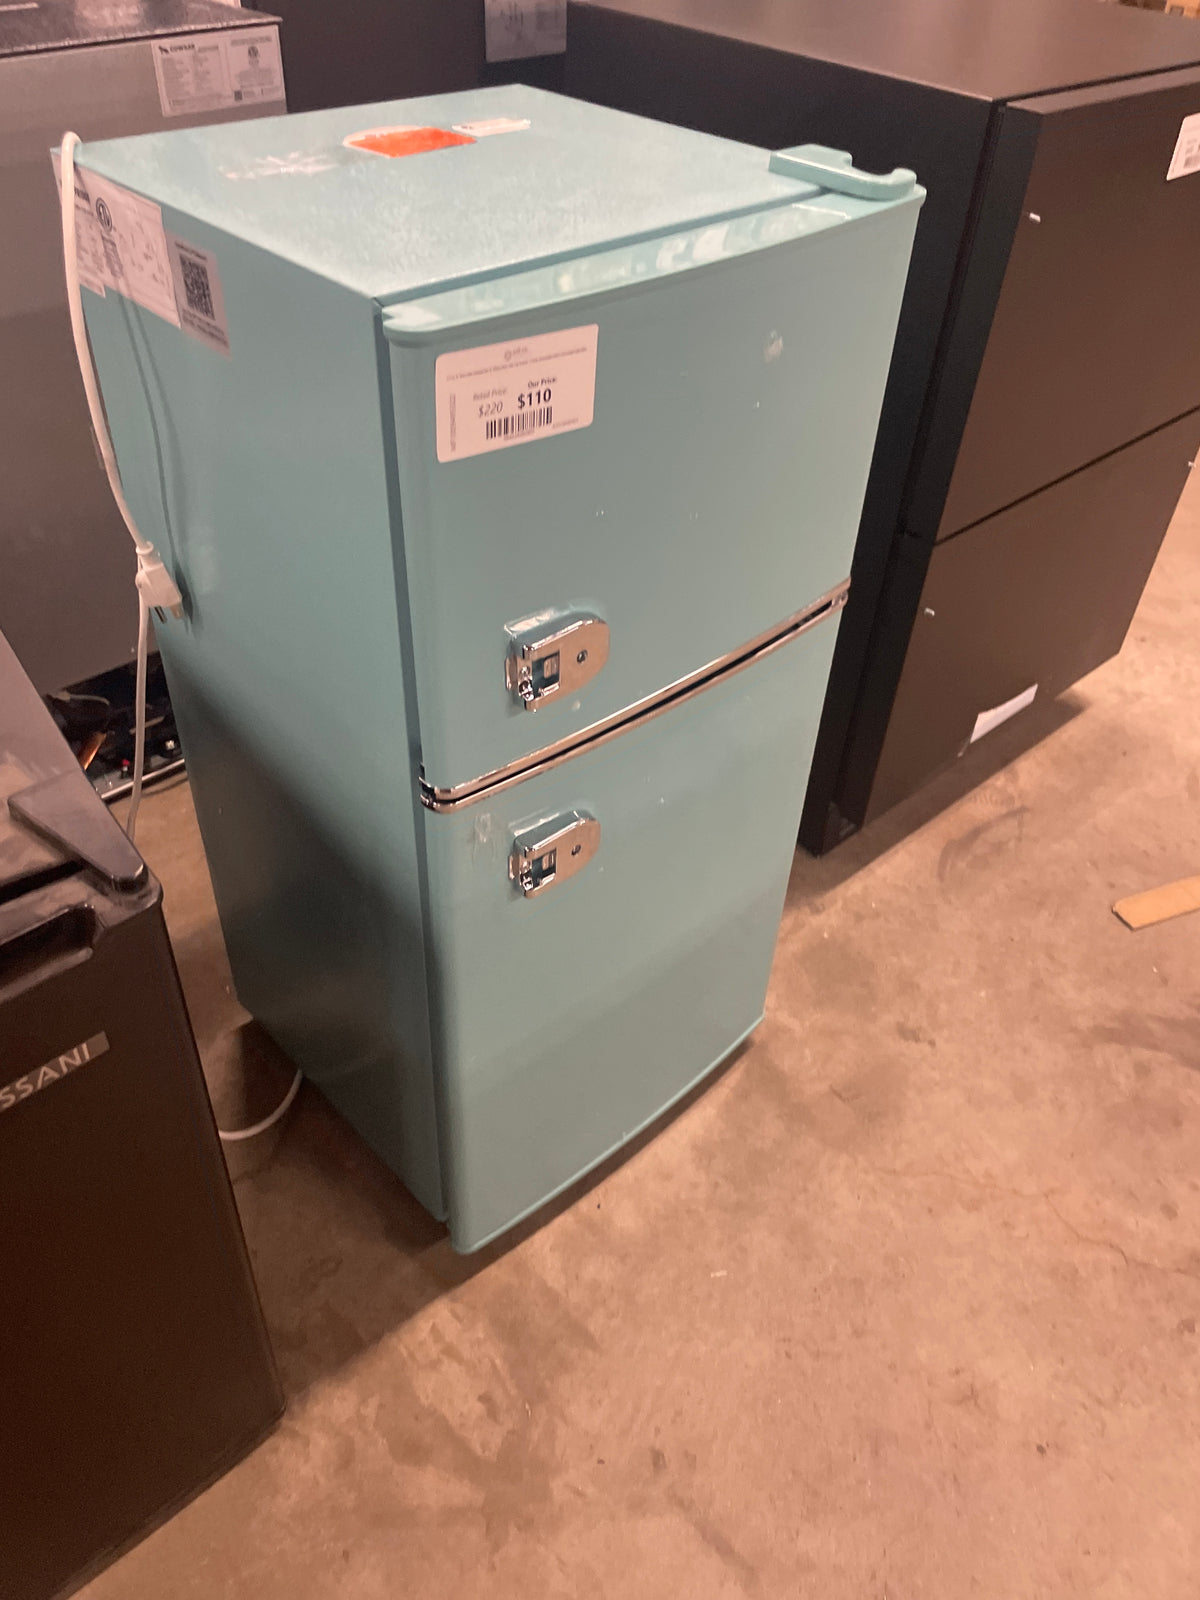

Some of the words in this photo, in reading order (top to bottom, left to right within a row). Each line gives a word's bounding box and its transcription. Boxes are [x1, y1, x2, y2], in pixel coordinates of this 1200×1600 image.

[528, 380, 539, 389] Our
[517, 388, 552, 410] $110
[478, 401, 503, 418] $220
